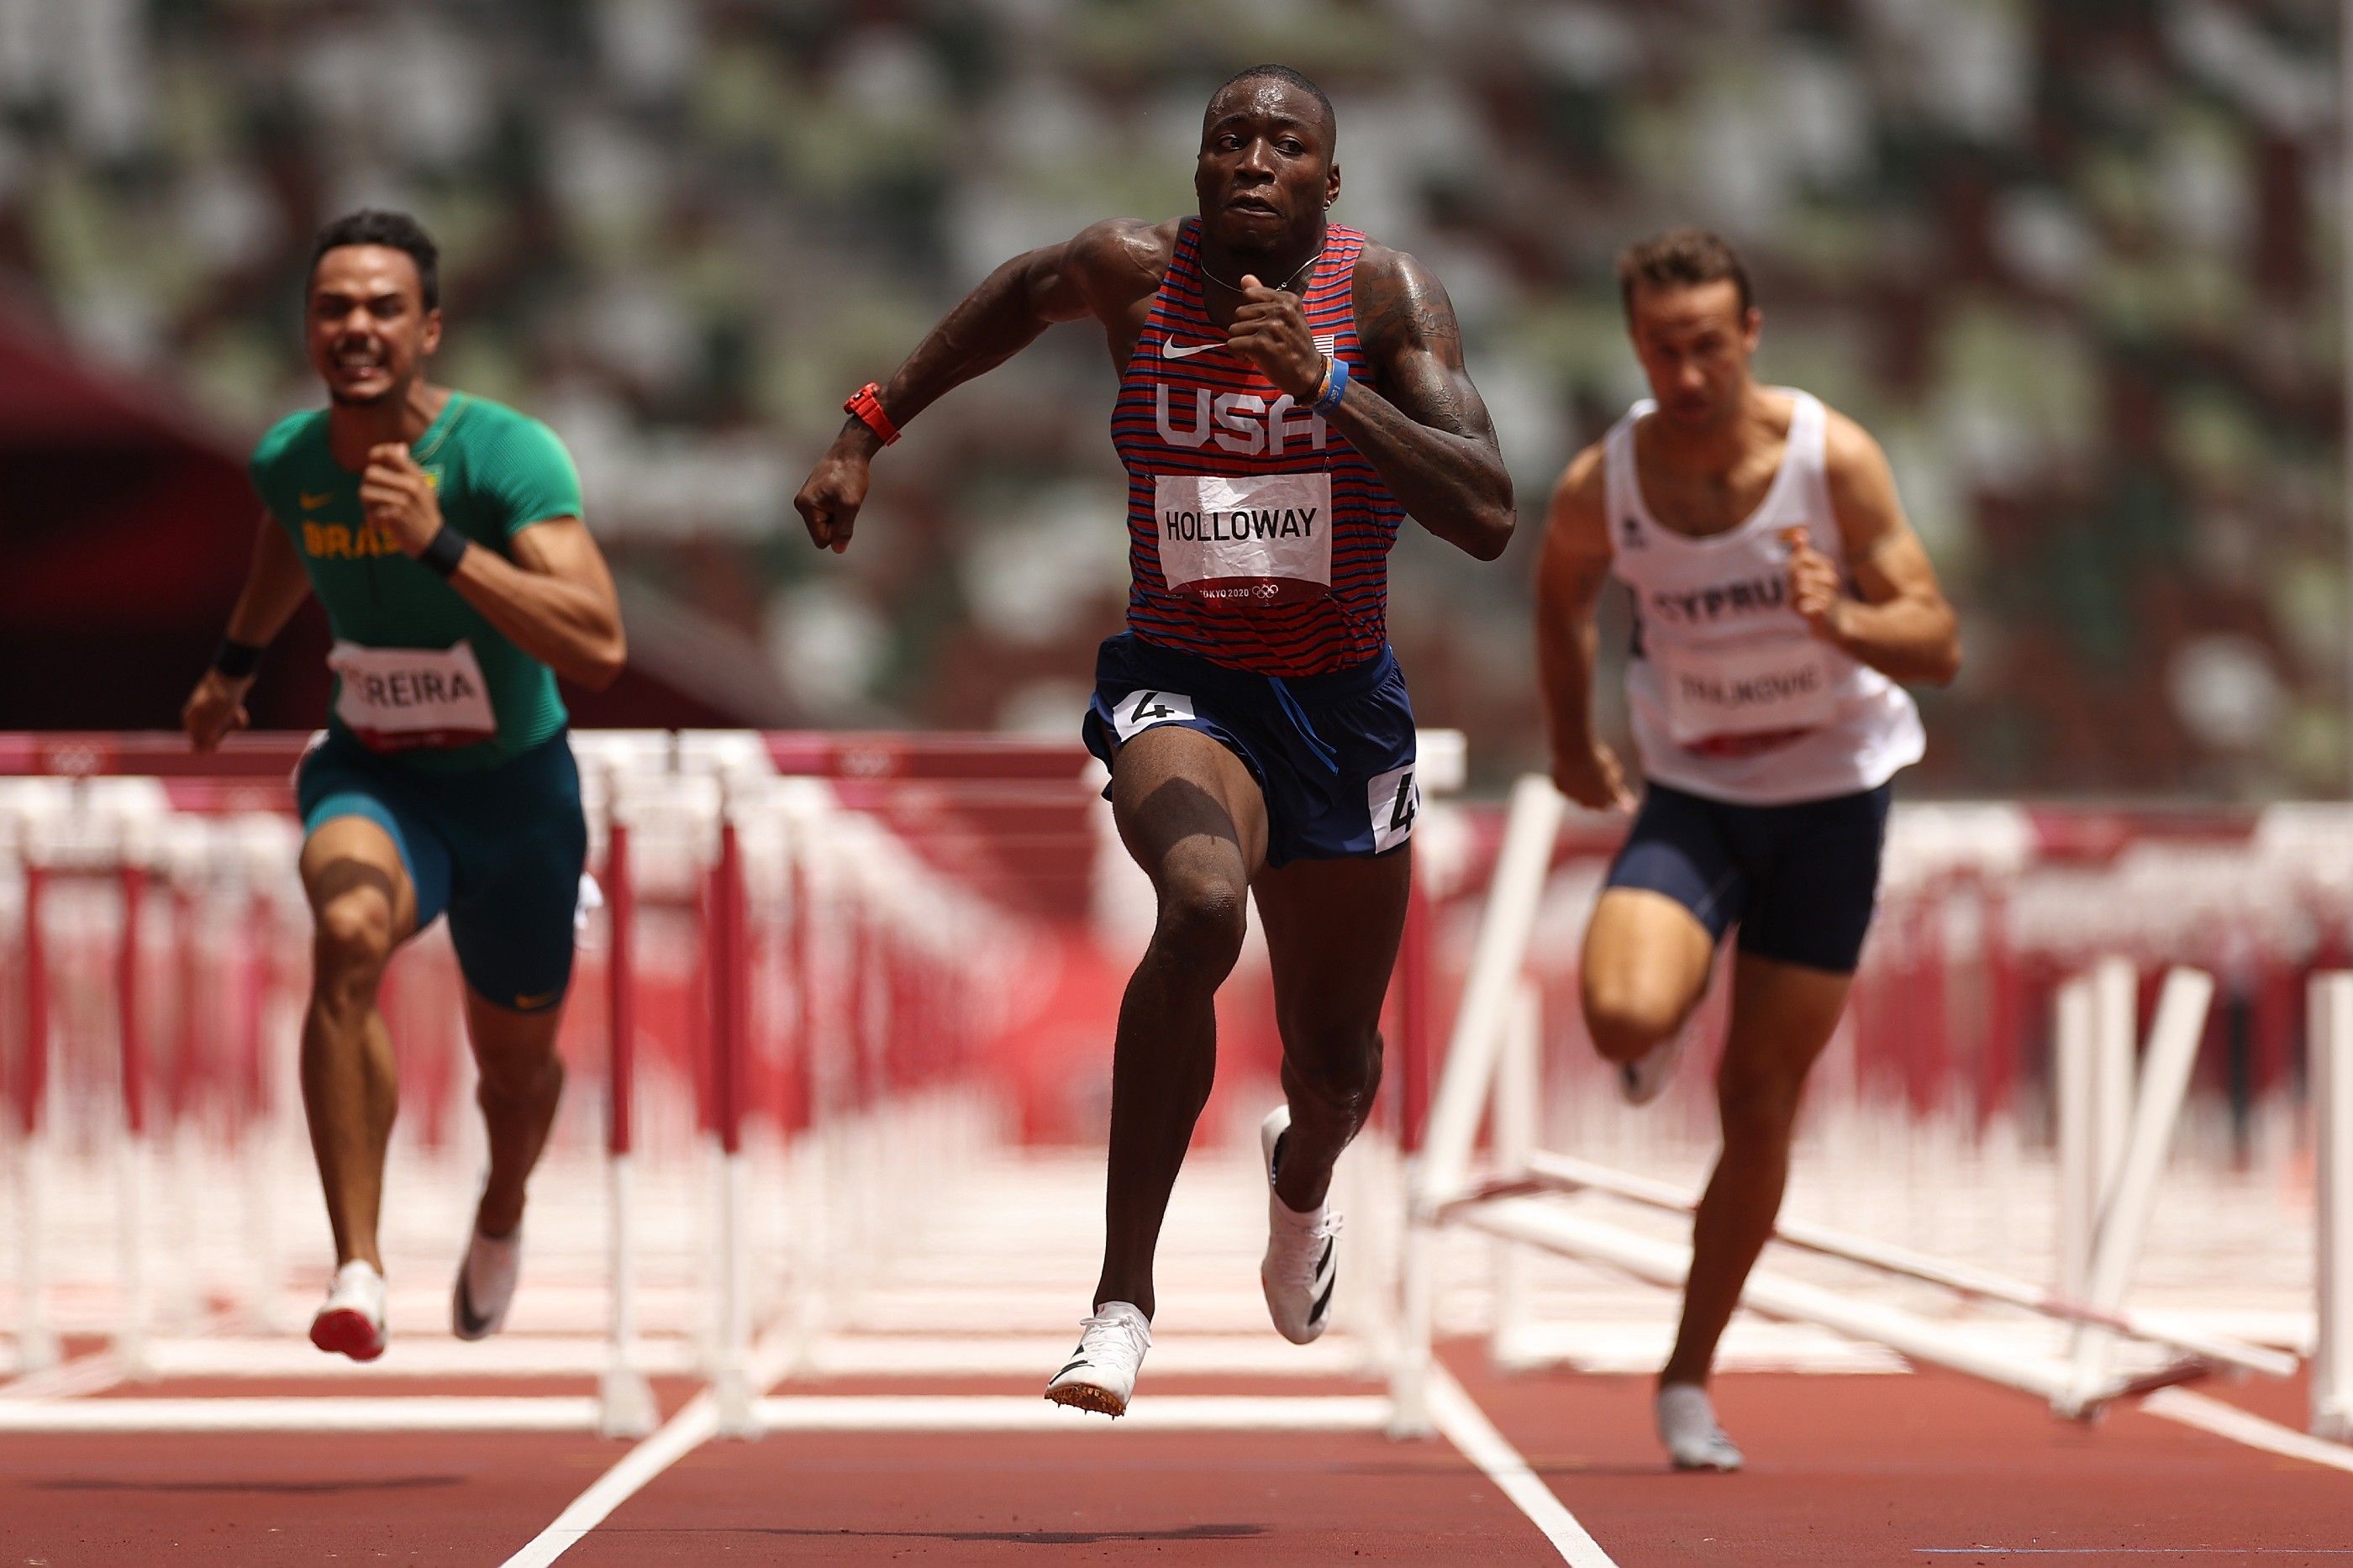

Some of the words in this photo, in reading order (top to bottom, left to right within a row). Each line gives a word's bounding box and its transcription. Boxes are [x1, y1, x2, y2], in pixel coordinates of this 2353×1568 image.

[1155, 383, 1326, 455] USA
[1166, 508, 1317, 542] HOLLOWAY
[1199, 589, 1226, 598] TOKYO
[1228, 589, 1249, 597] 2020
[1653, 576, 1785, 623] CYPRU
[360, 670, 476, 708] REIRA
[1131, 692, 1175, 724] 4
[1389, 771, 1416, 834] 4
